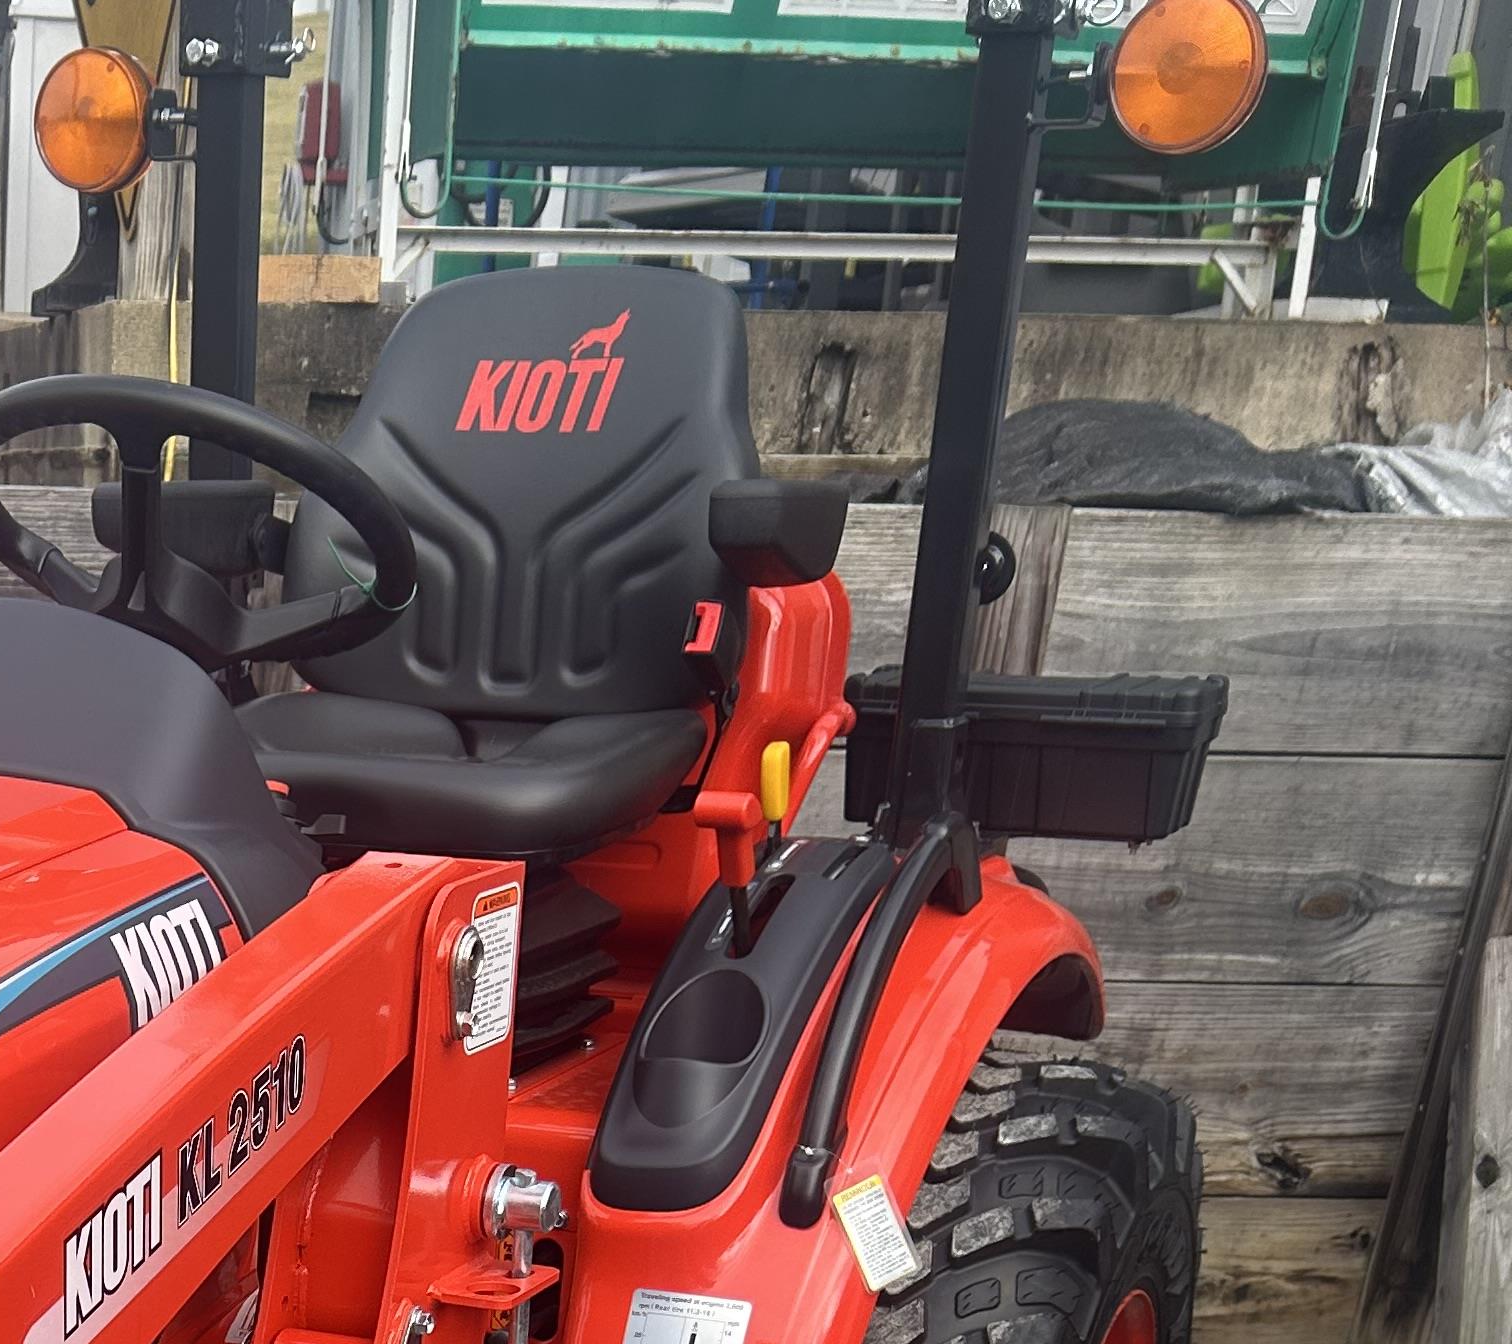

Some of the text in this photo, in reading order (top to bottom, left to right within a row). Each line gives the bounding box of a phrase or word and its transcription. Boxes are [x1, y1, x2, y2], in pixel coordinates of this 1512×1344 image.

[455, 358, 624, 433] KIOTI
[109, 898, 222, 1028] KIOTI
[63, 1034, 307, 1340] KIOTI KL 2510
